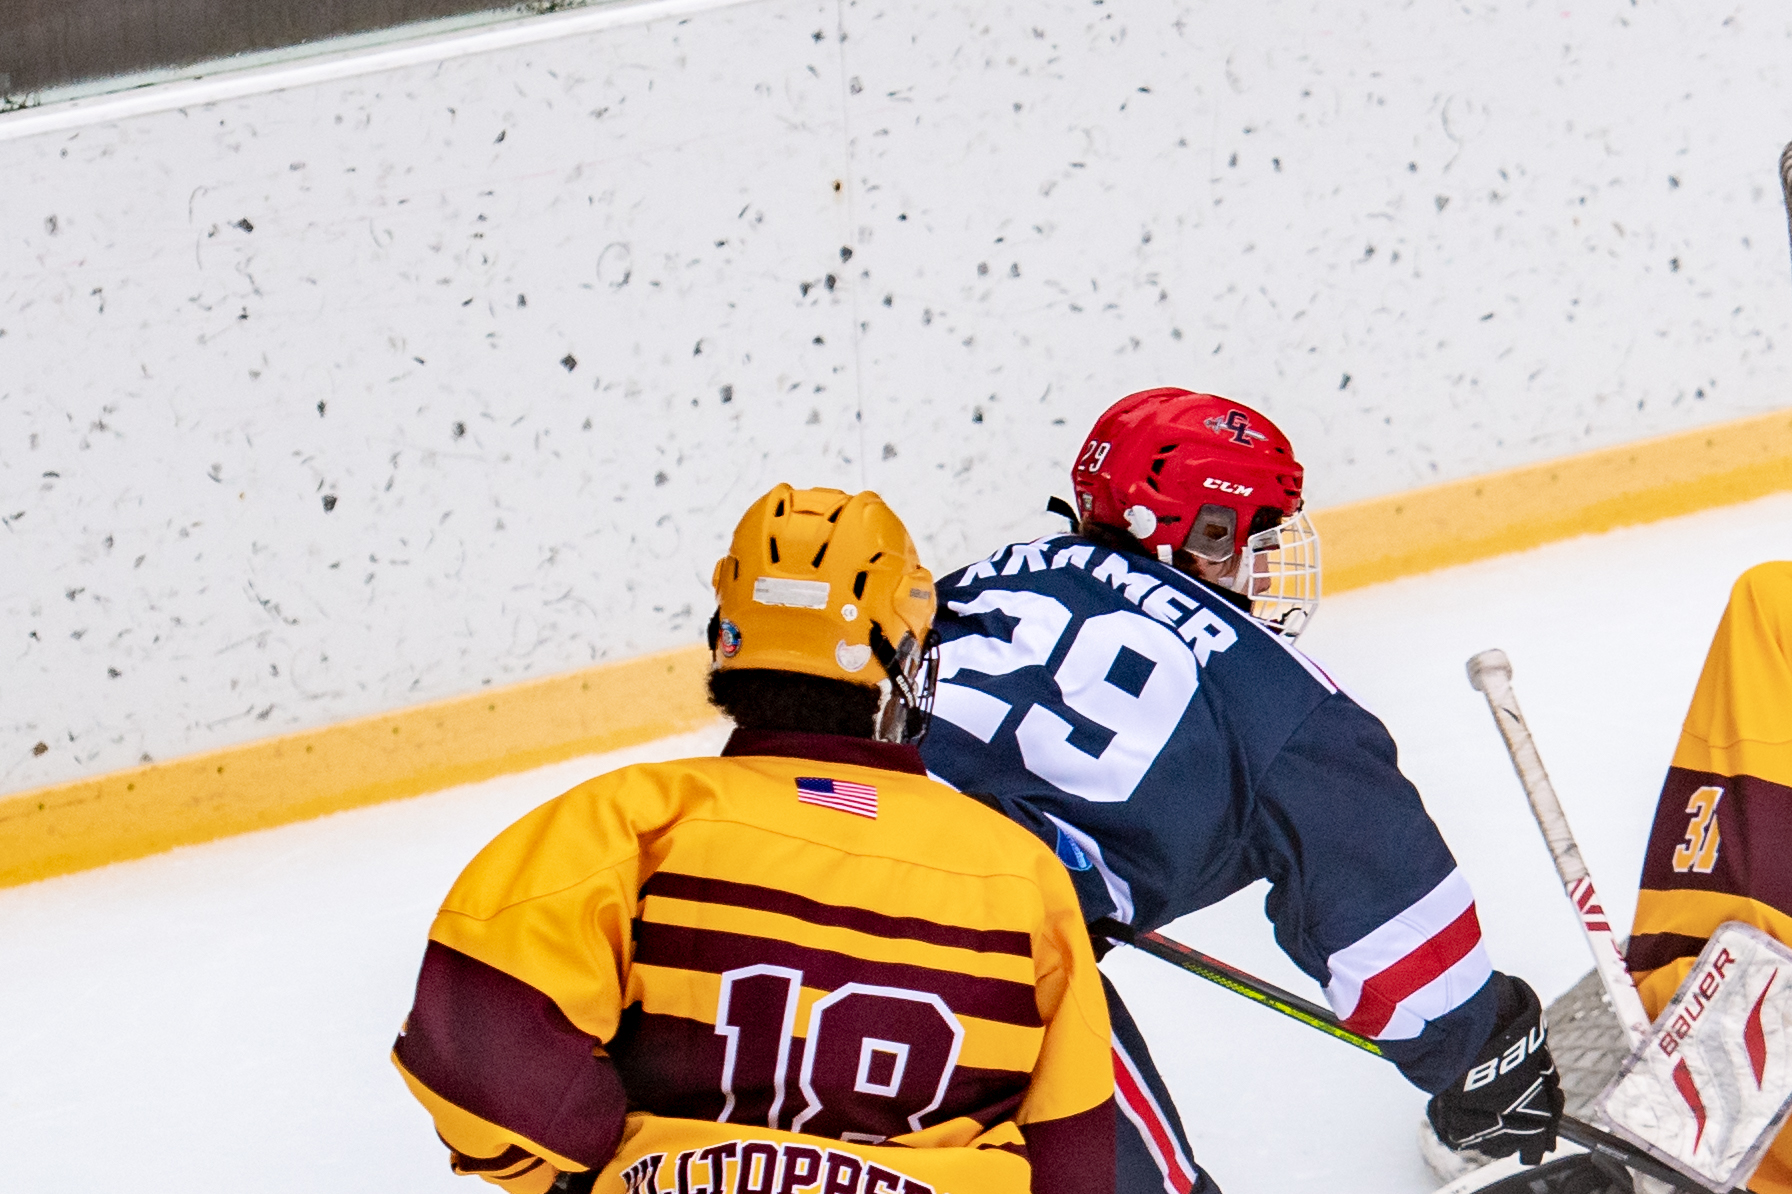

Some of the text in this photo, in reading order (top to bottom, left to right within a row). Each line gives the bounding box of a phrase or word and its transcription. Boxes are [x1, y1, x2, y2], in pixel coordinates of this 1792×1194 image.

[1077, 440, 1111, 472] 29
[931, 589, 1199, 802] 29
[1672, 786, 1725, 874] 31
